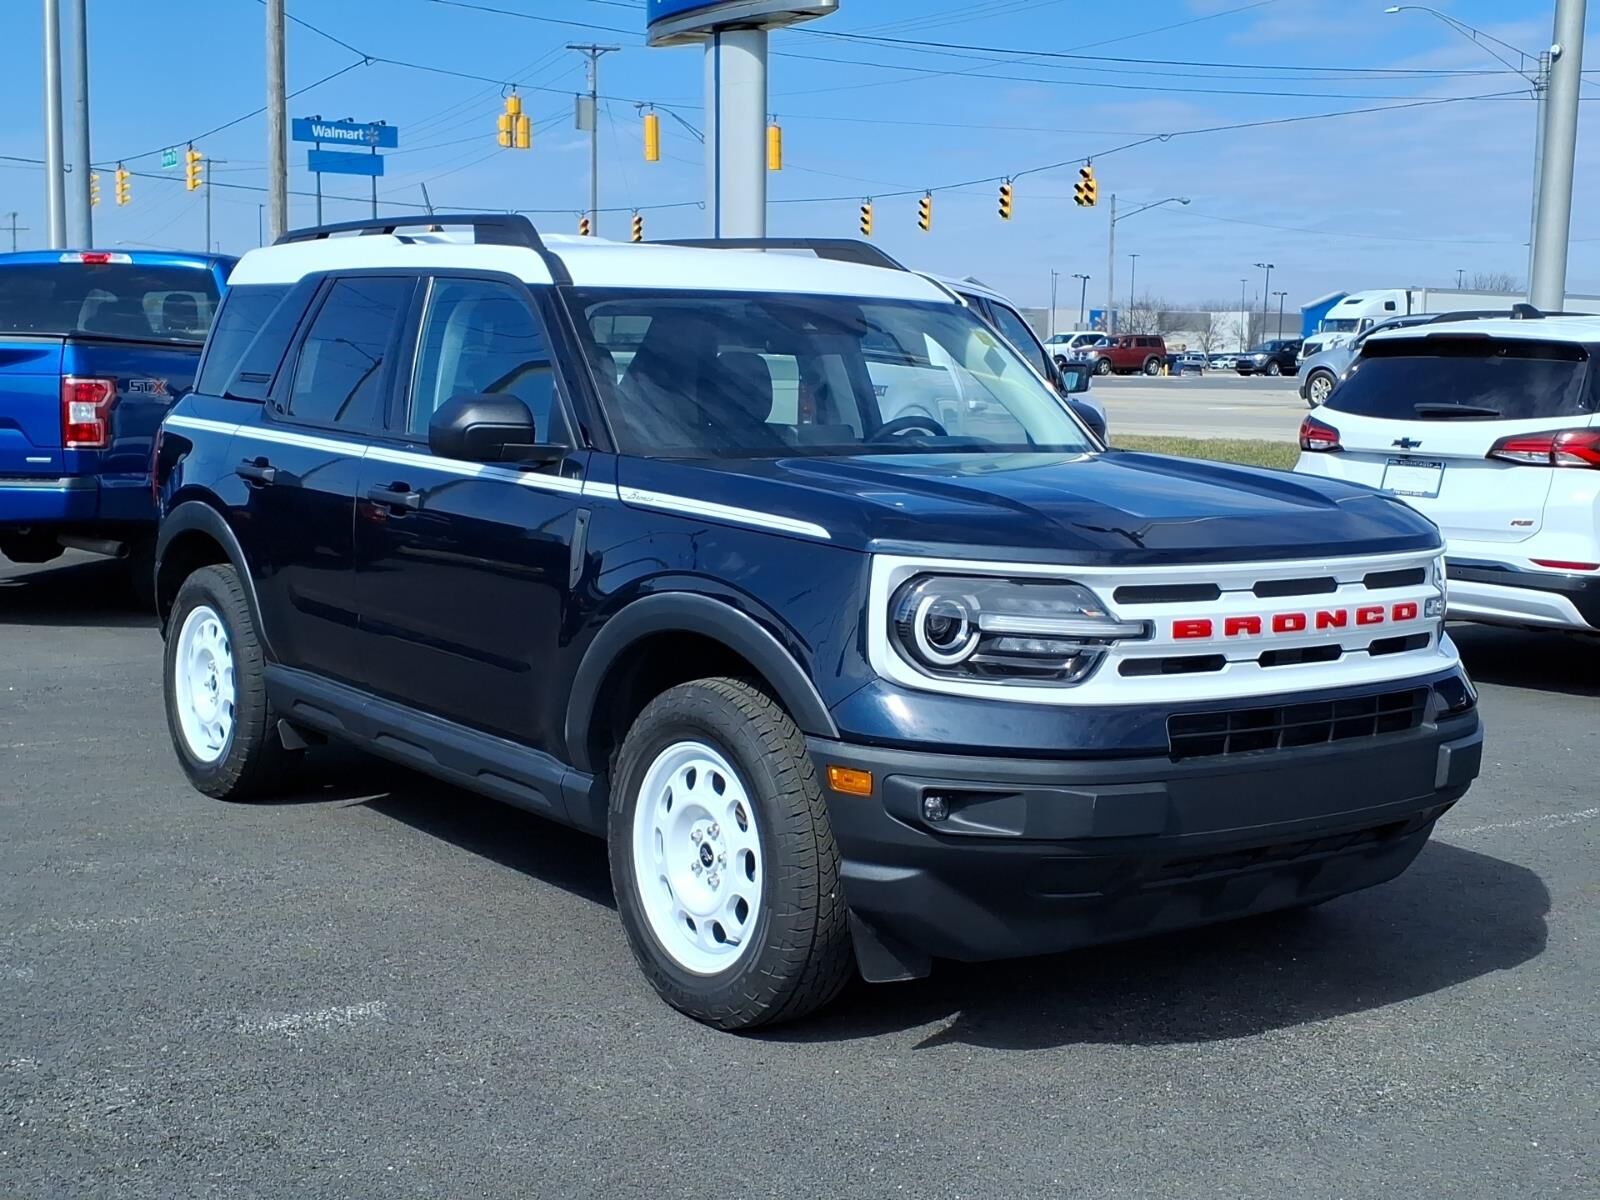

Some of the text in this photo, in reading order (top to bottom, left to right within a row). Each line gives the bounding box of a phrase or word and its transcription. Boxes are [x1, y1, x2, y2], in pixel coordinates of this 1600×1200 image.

[311, 124, 364, 141] Walmart
[128, 378, 168, 395] STX
[1171, 602, 1418, 640] BRONCO
